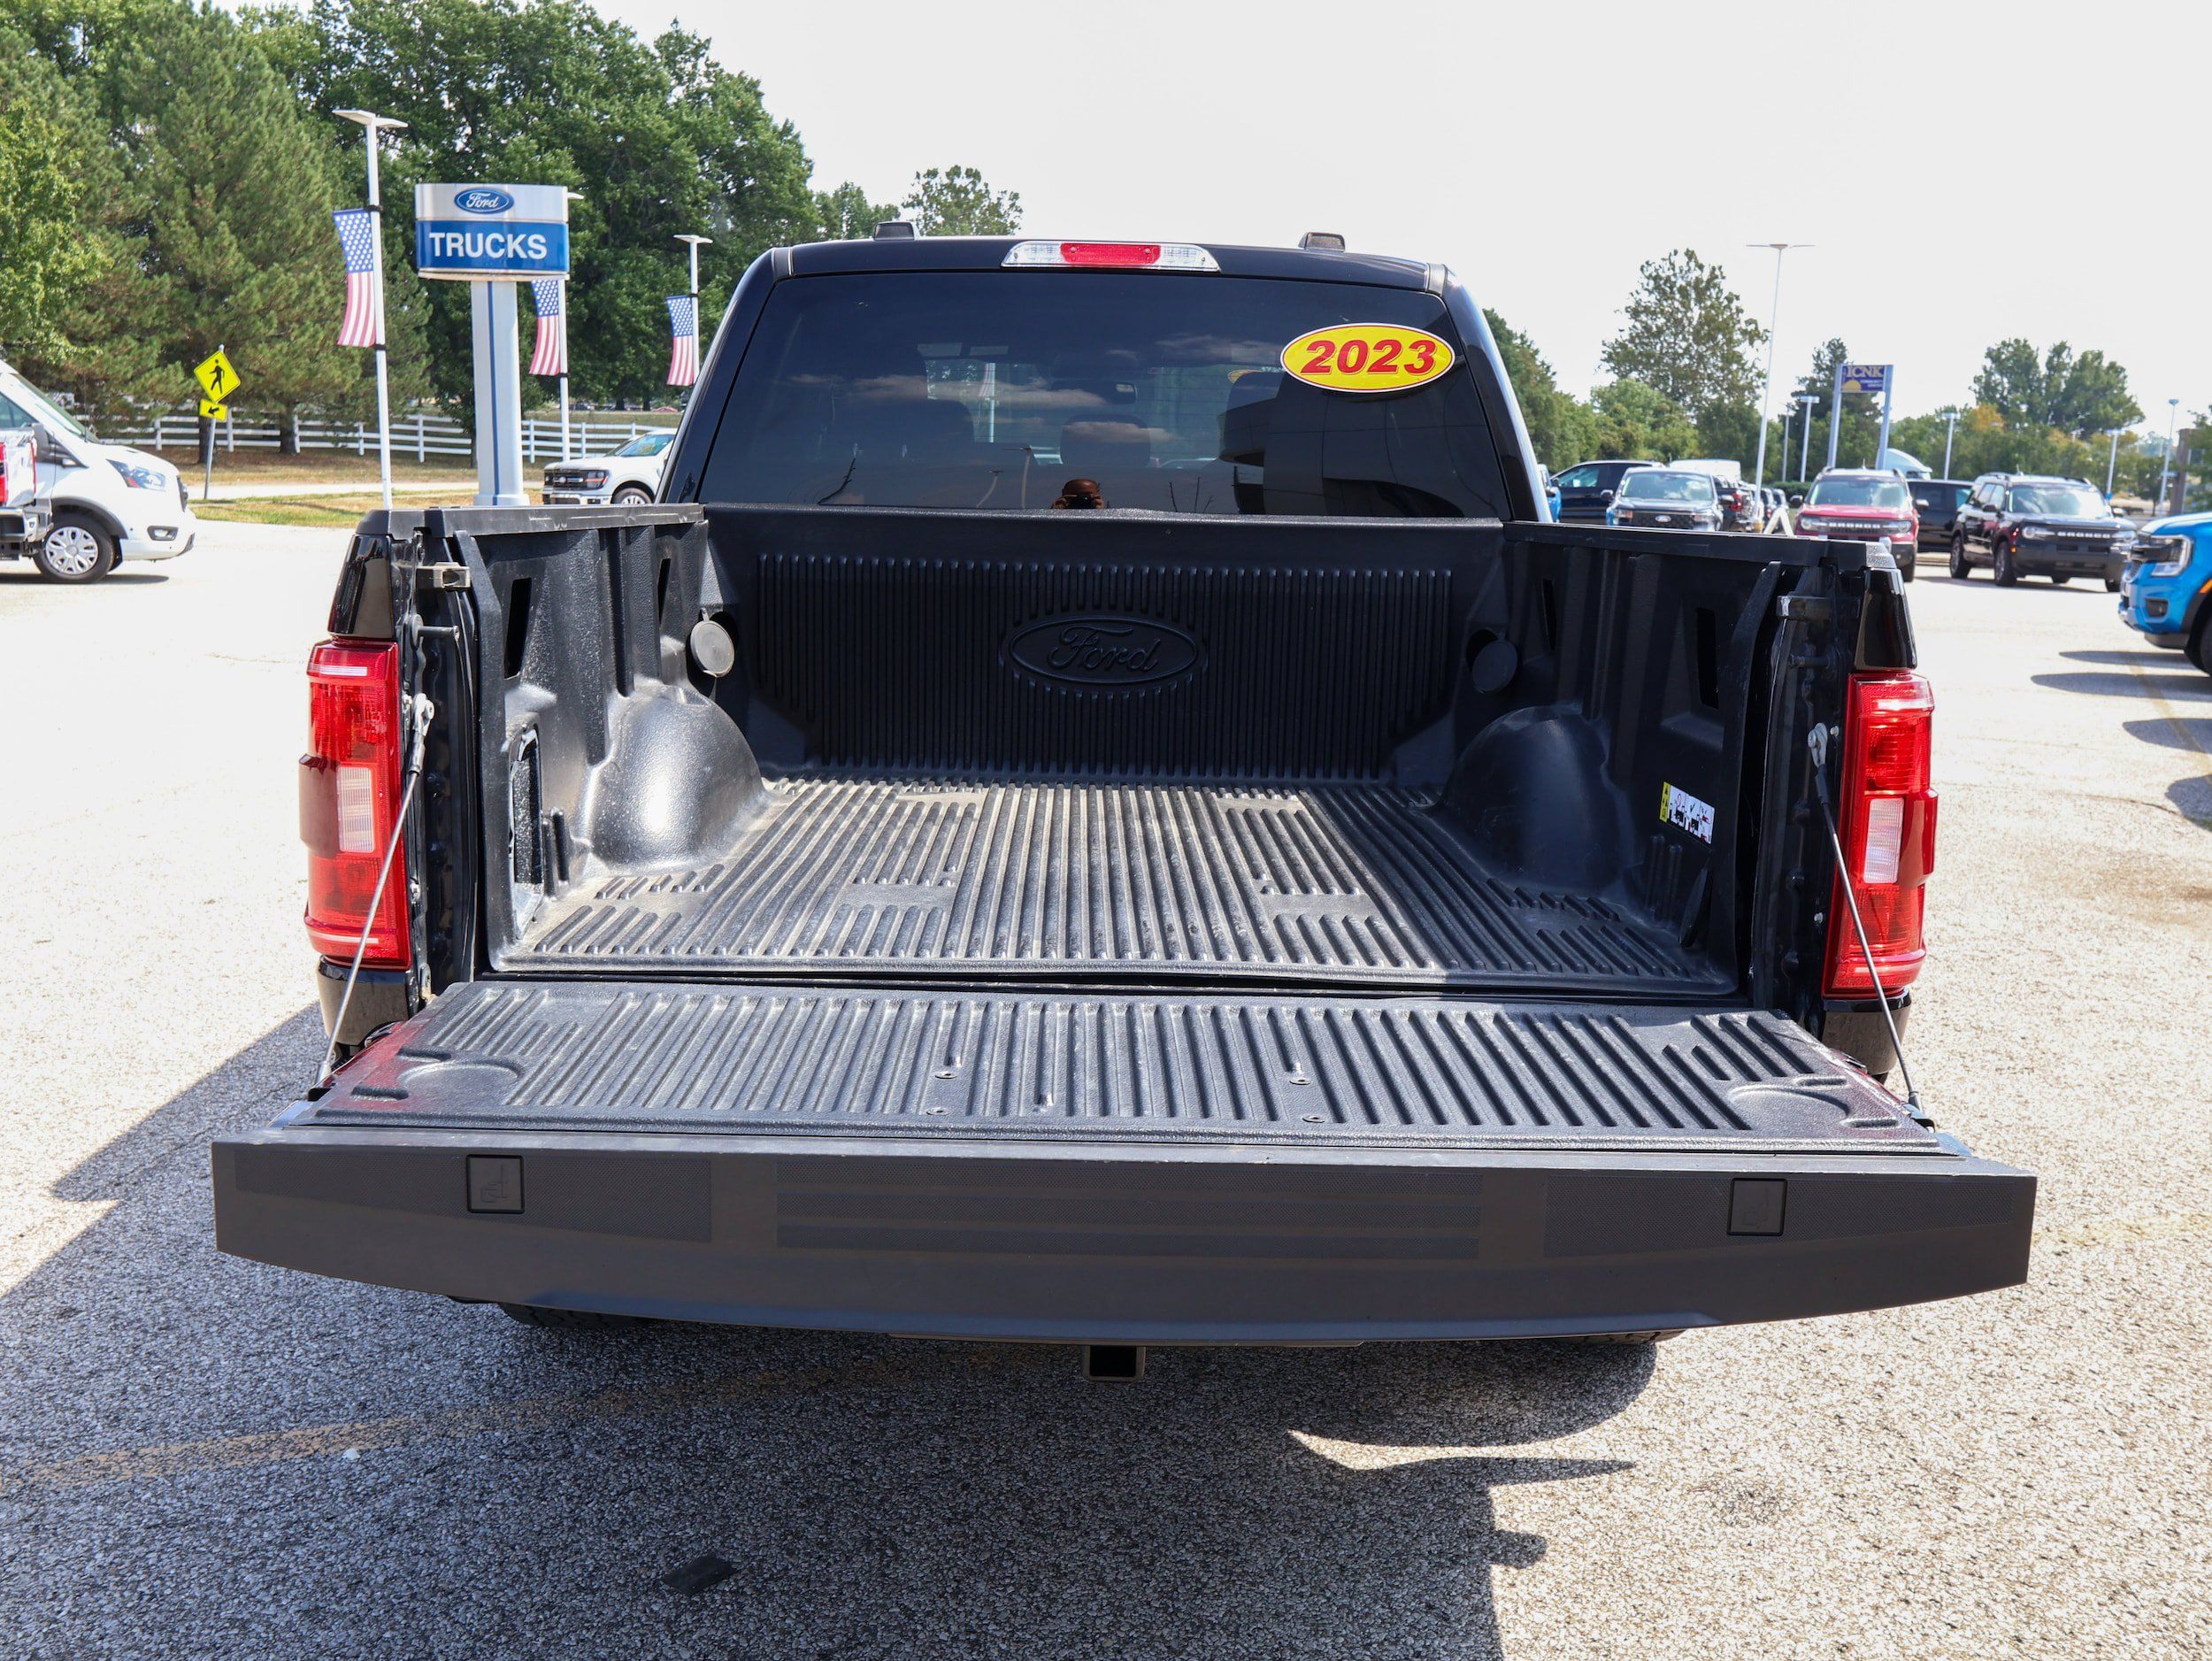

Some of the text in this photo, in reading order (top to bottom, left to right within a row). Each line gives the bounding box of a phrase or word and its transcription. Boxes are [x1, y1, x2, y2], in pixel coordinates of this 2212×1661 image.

[465, 192, 500, 209] Ford
[428, 232, 548, 260] TRUCKS
[1300, 339, 1437, 376] 2023
[1046, 623, 1162, 672] Ford
